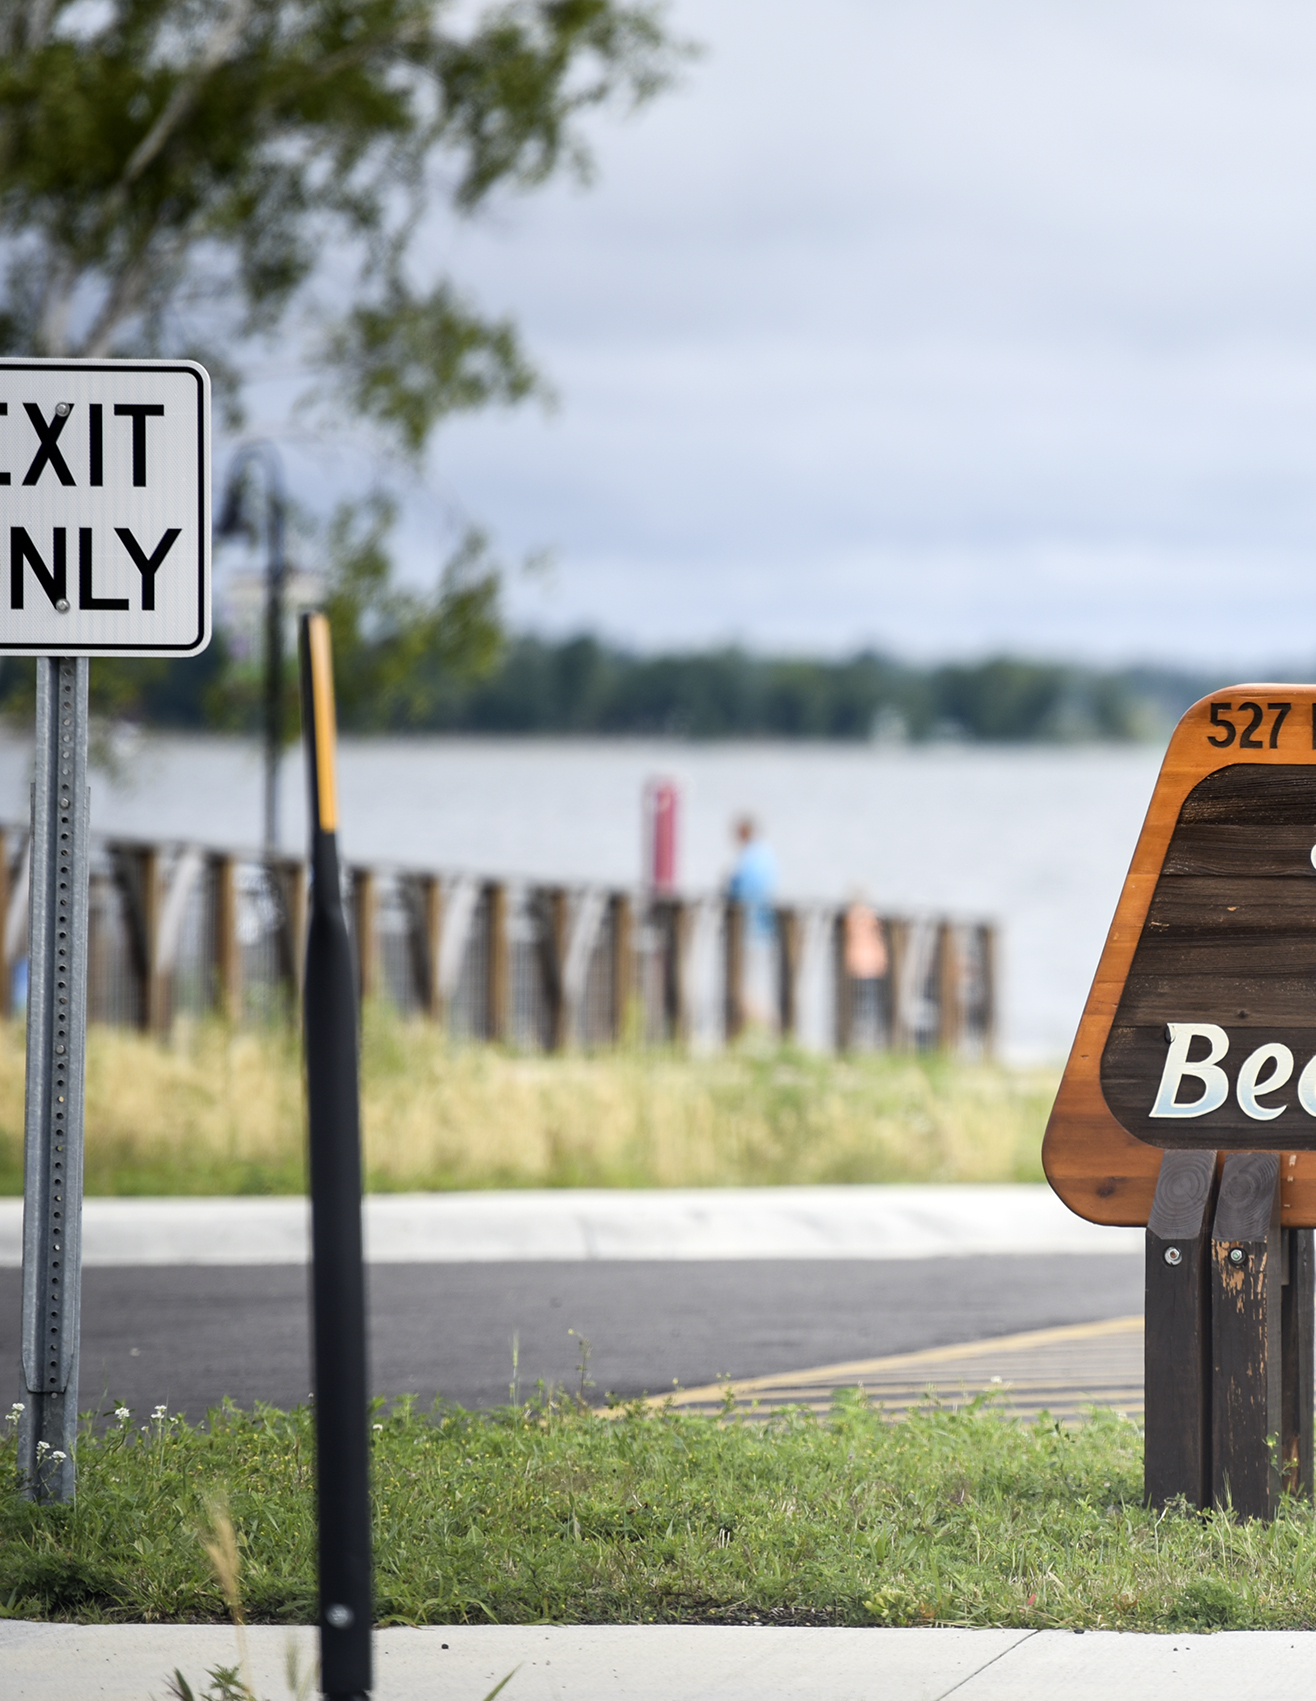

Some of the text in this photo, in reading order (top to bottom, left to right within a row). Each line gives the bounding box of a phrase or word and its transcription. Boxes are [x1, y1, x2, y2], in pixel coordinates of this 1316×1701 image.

[0, 402, 165, 487] XIT
[10, 526, 183, 611] NLY
[1207, 702, 1292, 749] 527
